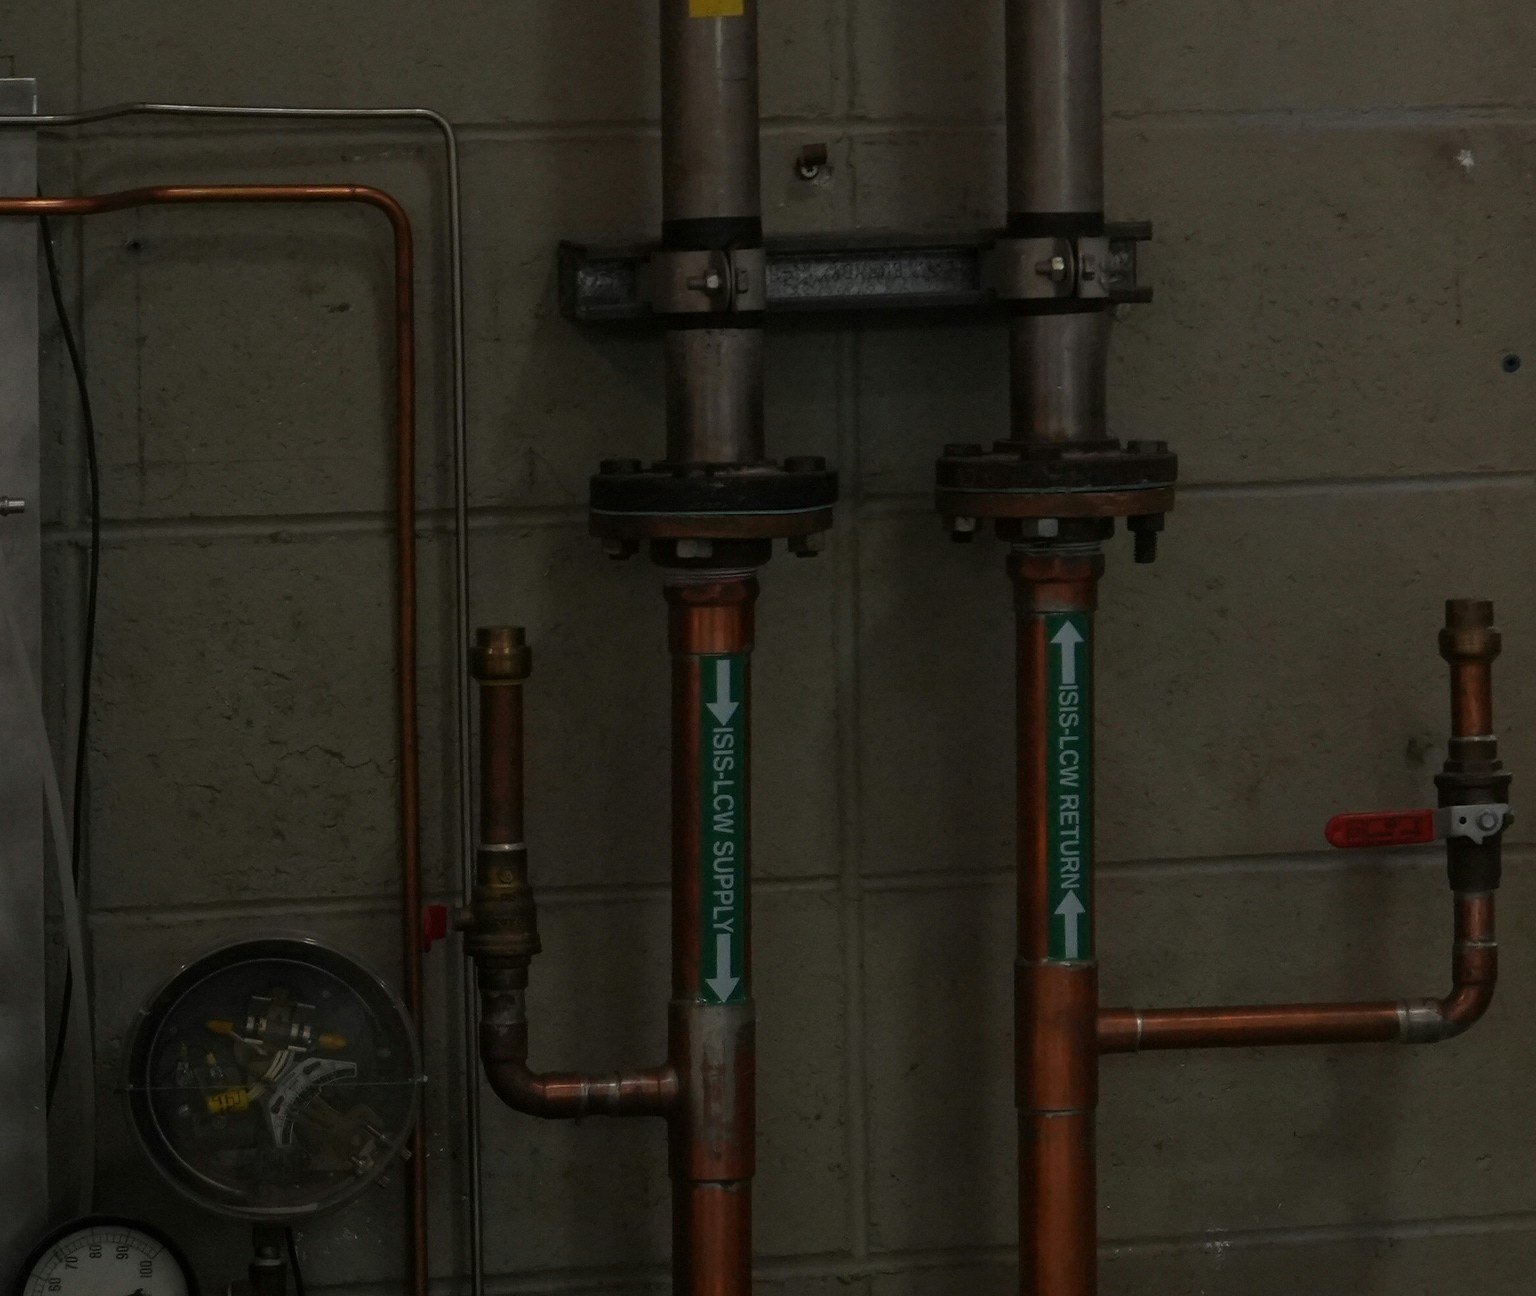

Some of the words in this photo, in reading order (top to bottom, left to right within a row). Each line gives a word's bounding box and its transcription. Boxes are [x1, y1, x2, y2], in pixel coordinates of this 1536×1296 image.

[1058, 684, 1081, 787] ISIS-LCW
[712, 726, 735, 833] ISIS-LCW
[1059, 794, 1081, 889] RETURN
[712, 840, 735, 934] SUPPLY
[65, 1256, 79, 1270] 70
[89, 1244, 102, 1259] 80
[116, 1245, 129, 1260] 90
[139, 1260, 153, 1279] 100
